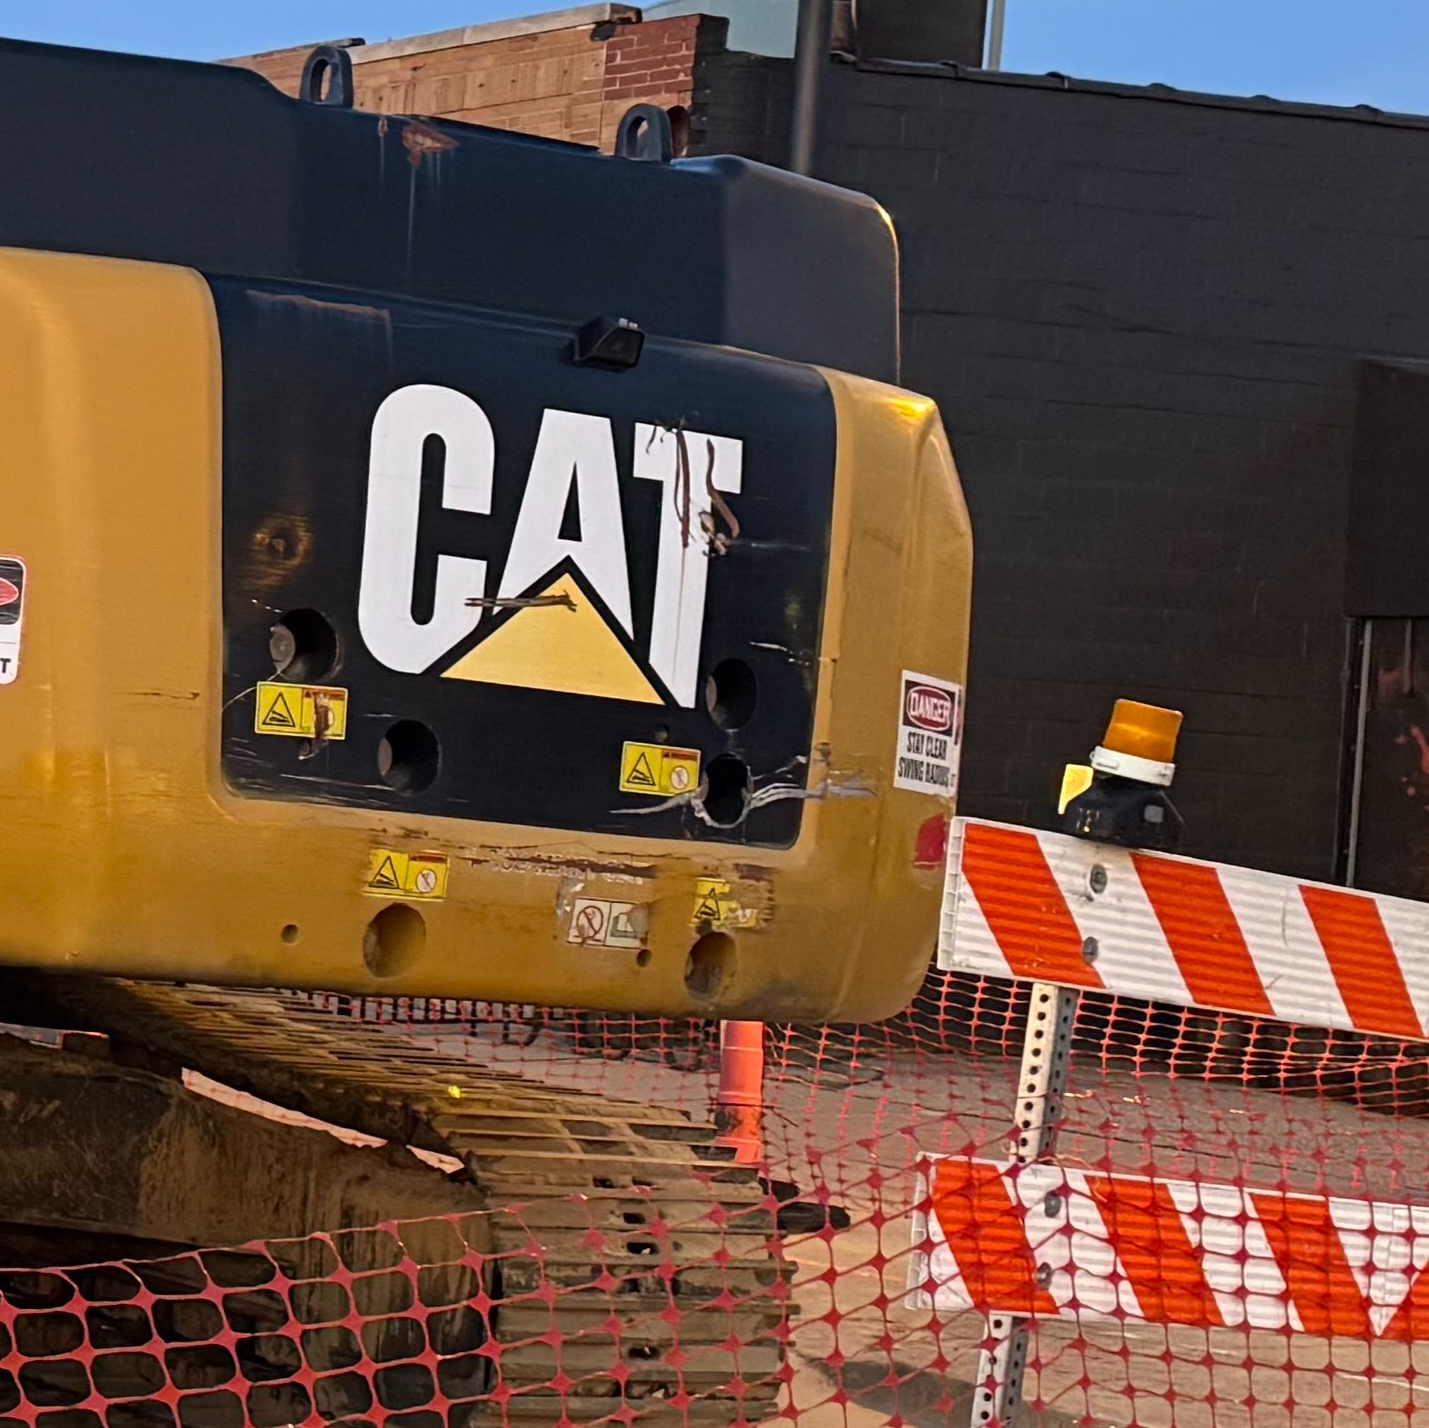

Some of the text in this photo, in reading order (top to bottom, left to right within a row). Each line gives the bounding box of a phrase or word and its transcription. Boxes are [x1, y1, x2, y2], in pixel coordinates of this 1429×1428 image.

[357, 384, 743, 708] CAT
[910, 692, 952, 723] DANGER
[907, 732, 948, 761] STAY CLEAR
[898, 756, 924, 782] SWING
